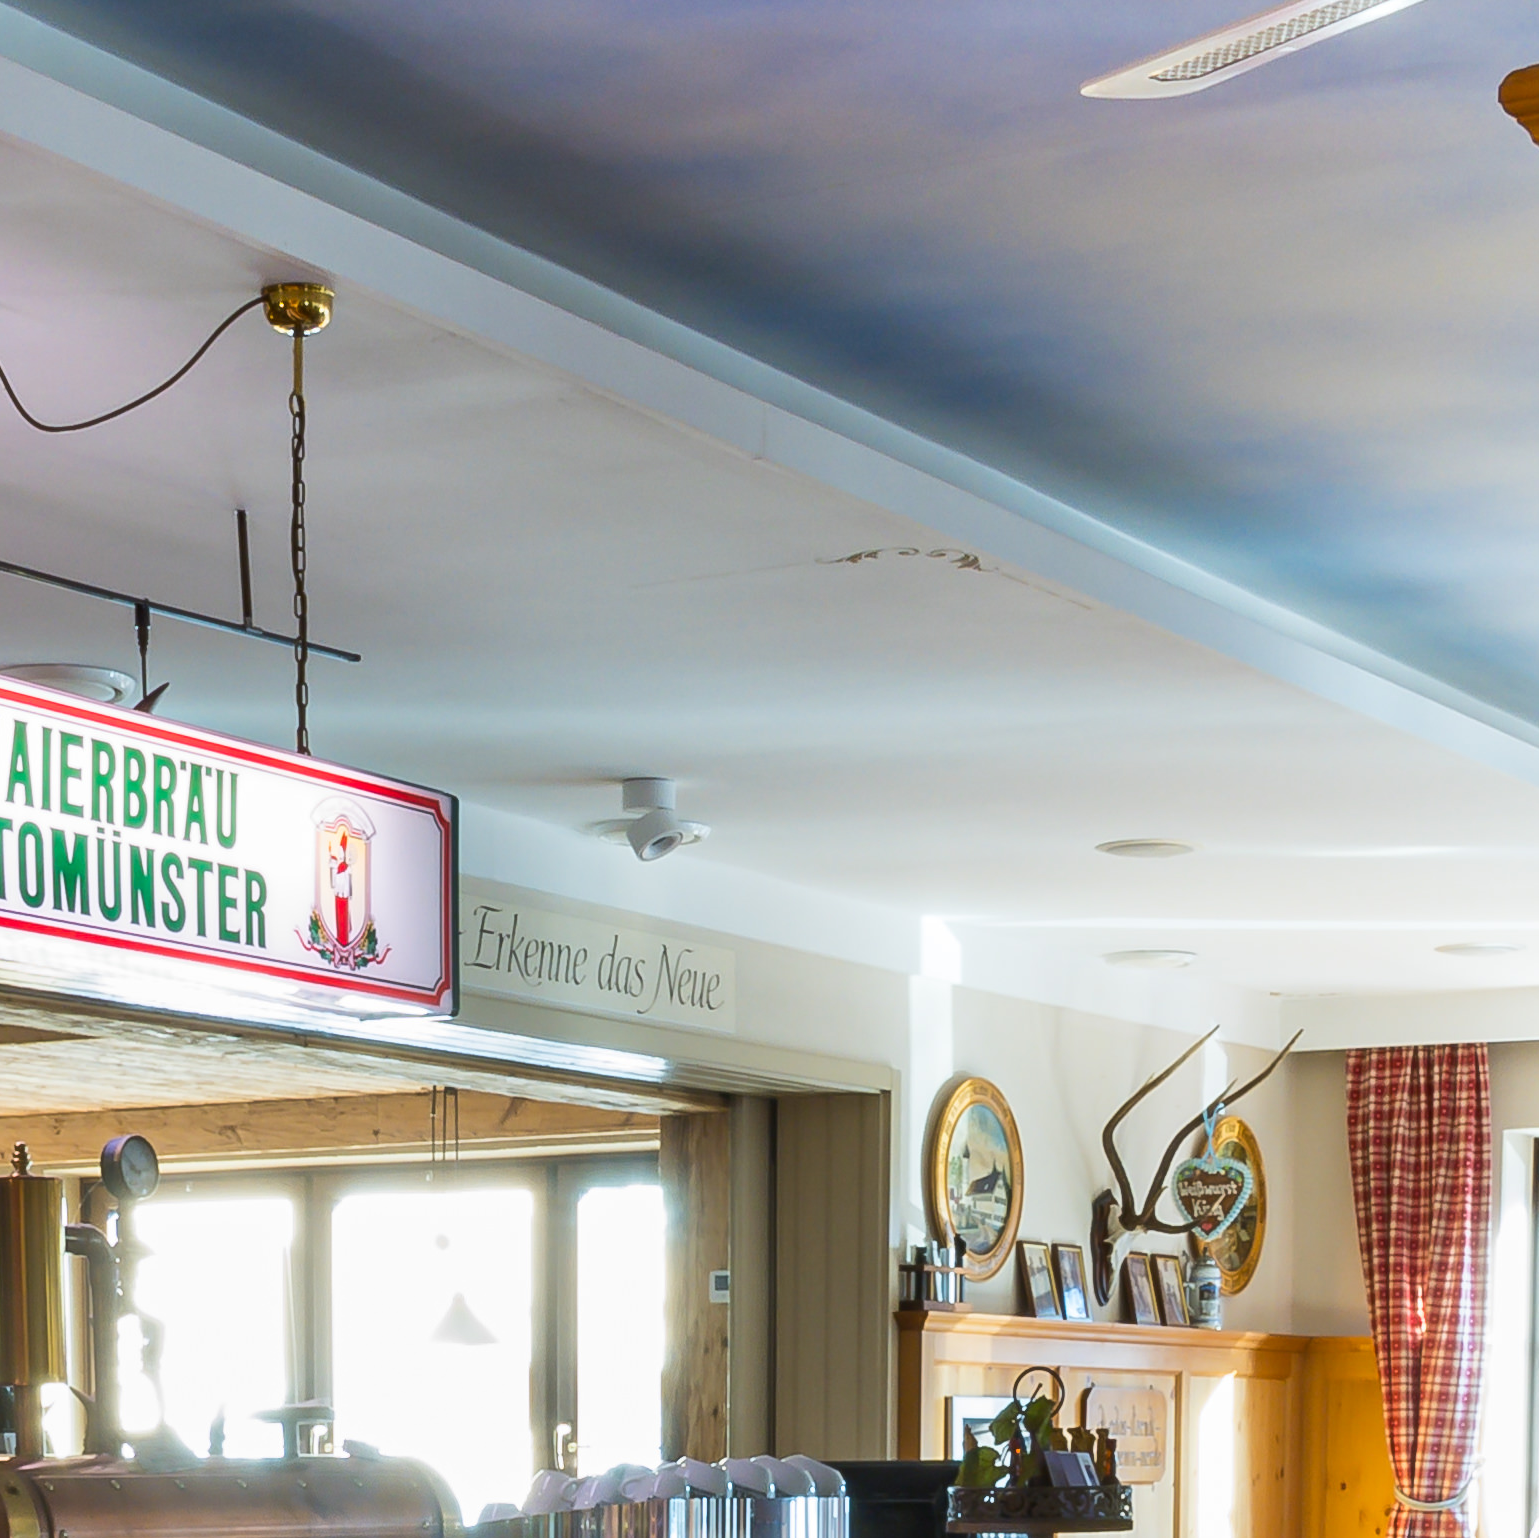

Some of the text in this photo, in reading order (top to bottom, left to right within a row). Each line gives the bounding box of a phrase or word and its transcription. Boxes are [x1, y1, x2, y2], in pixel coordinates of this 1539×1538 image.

[464, 905, 725, 1014] Erkenne das Neue
